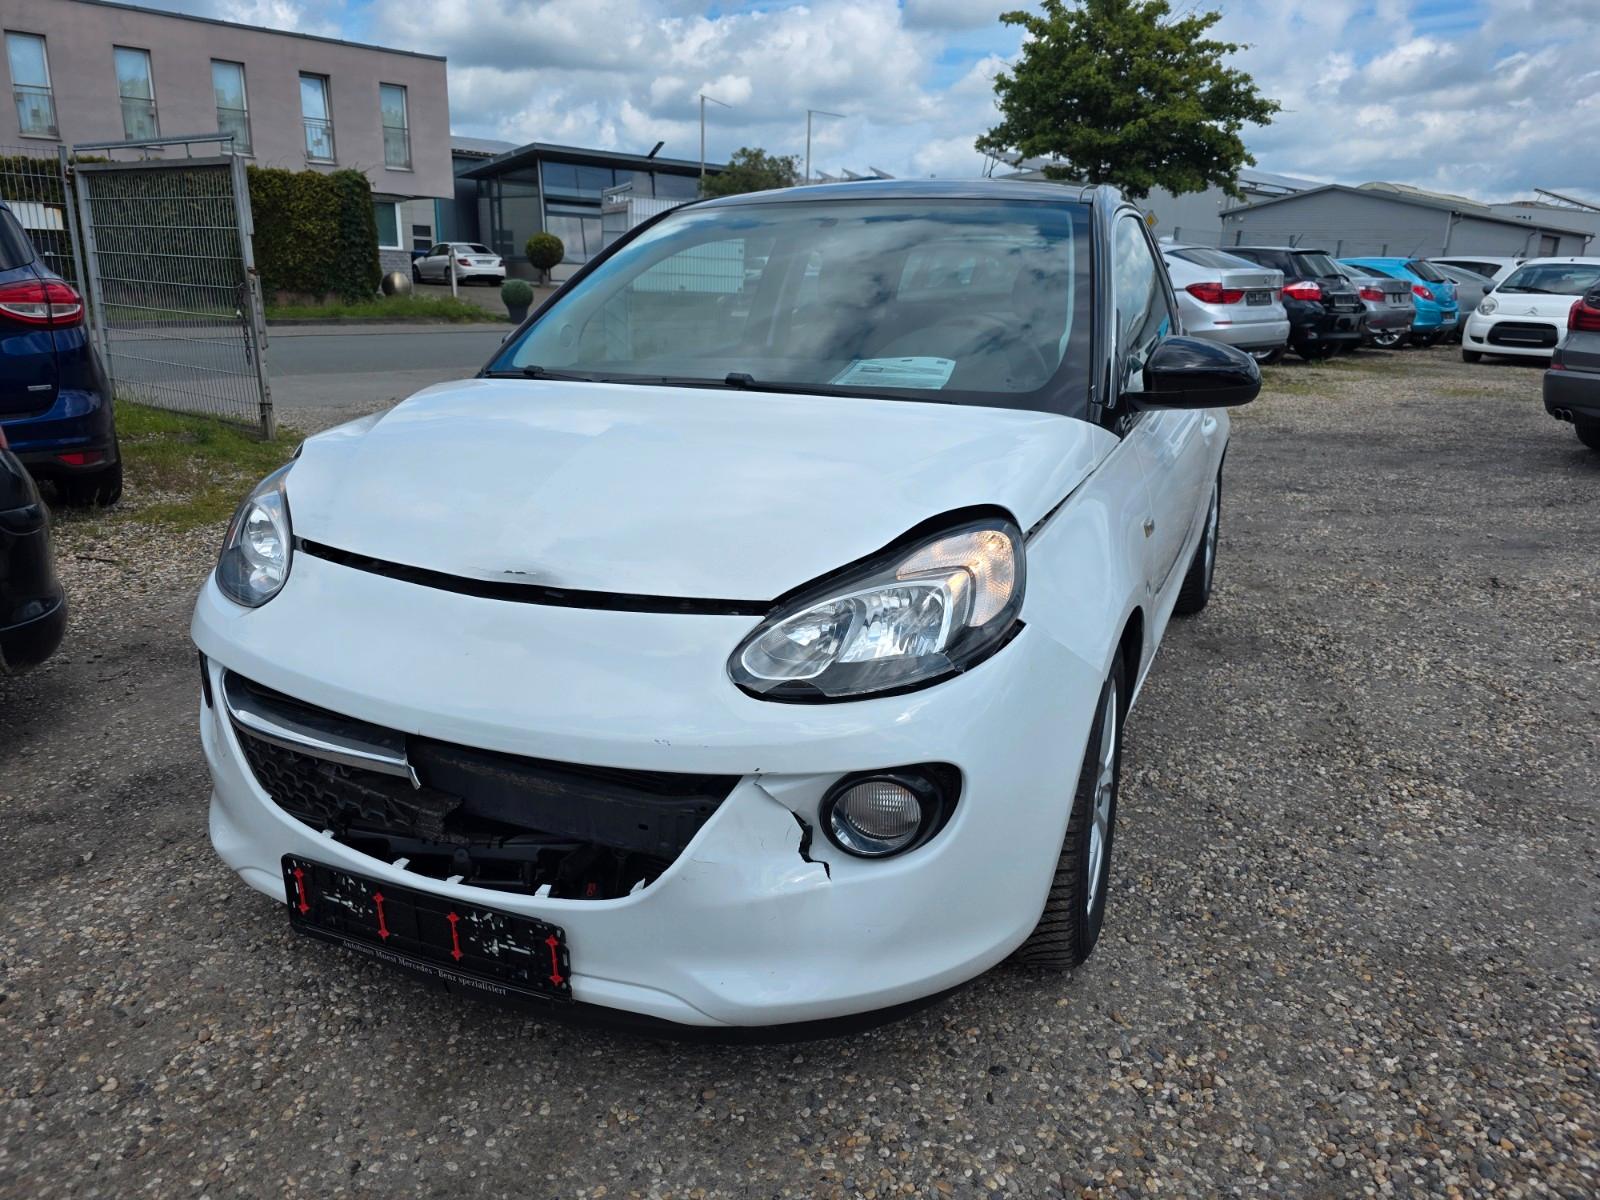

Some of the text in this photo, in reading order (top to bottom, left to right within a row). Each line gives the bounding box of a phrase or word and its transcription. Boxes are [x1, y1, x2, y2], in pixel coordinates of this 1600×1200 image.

[398, 957, 433, 975] Mercedes
[438, 970, 457, 982] Benz
[458, 975, 507, 996] spezialisiert
